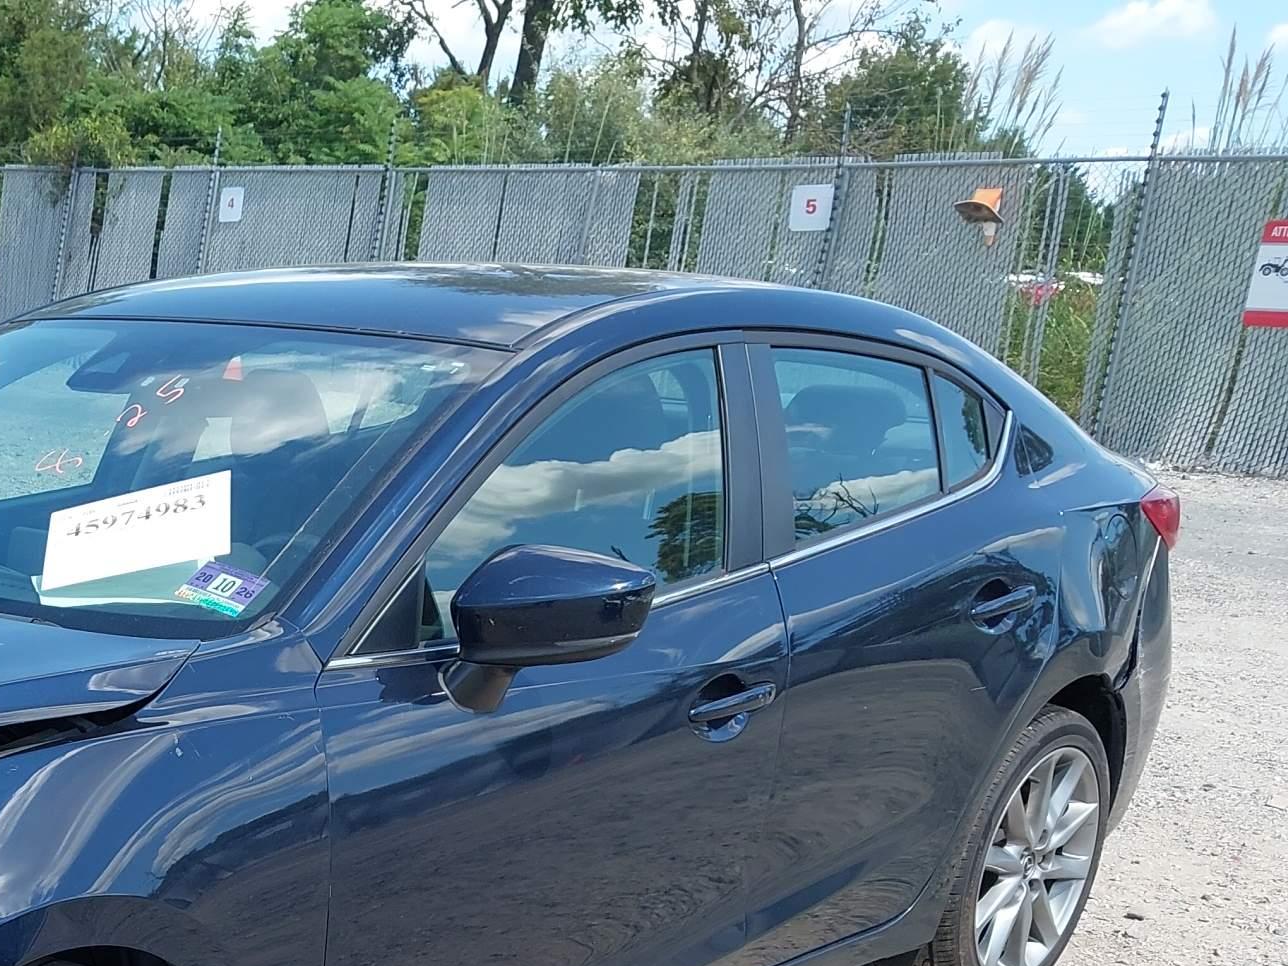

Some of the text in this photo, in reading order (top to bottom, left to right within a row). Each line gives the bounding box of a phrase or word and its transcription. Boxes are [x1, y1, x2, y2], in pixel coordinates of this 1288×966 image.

[227, 197, 234, 208] 4
[806, 198, 817, 215] 5
[1271, 225, 1288, 238] ATT
[66, 494, 206, 537] 45974983
[195, 571, 214, 584] 20
[212, 577, 237, 594] 10
[235, 586, 256, 599] 26
